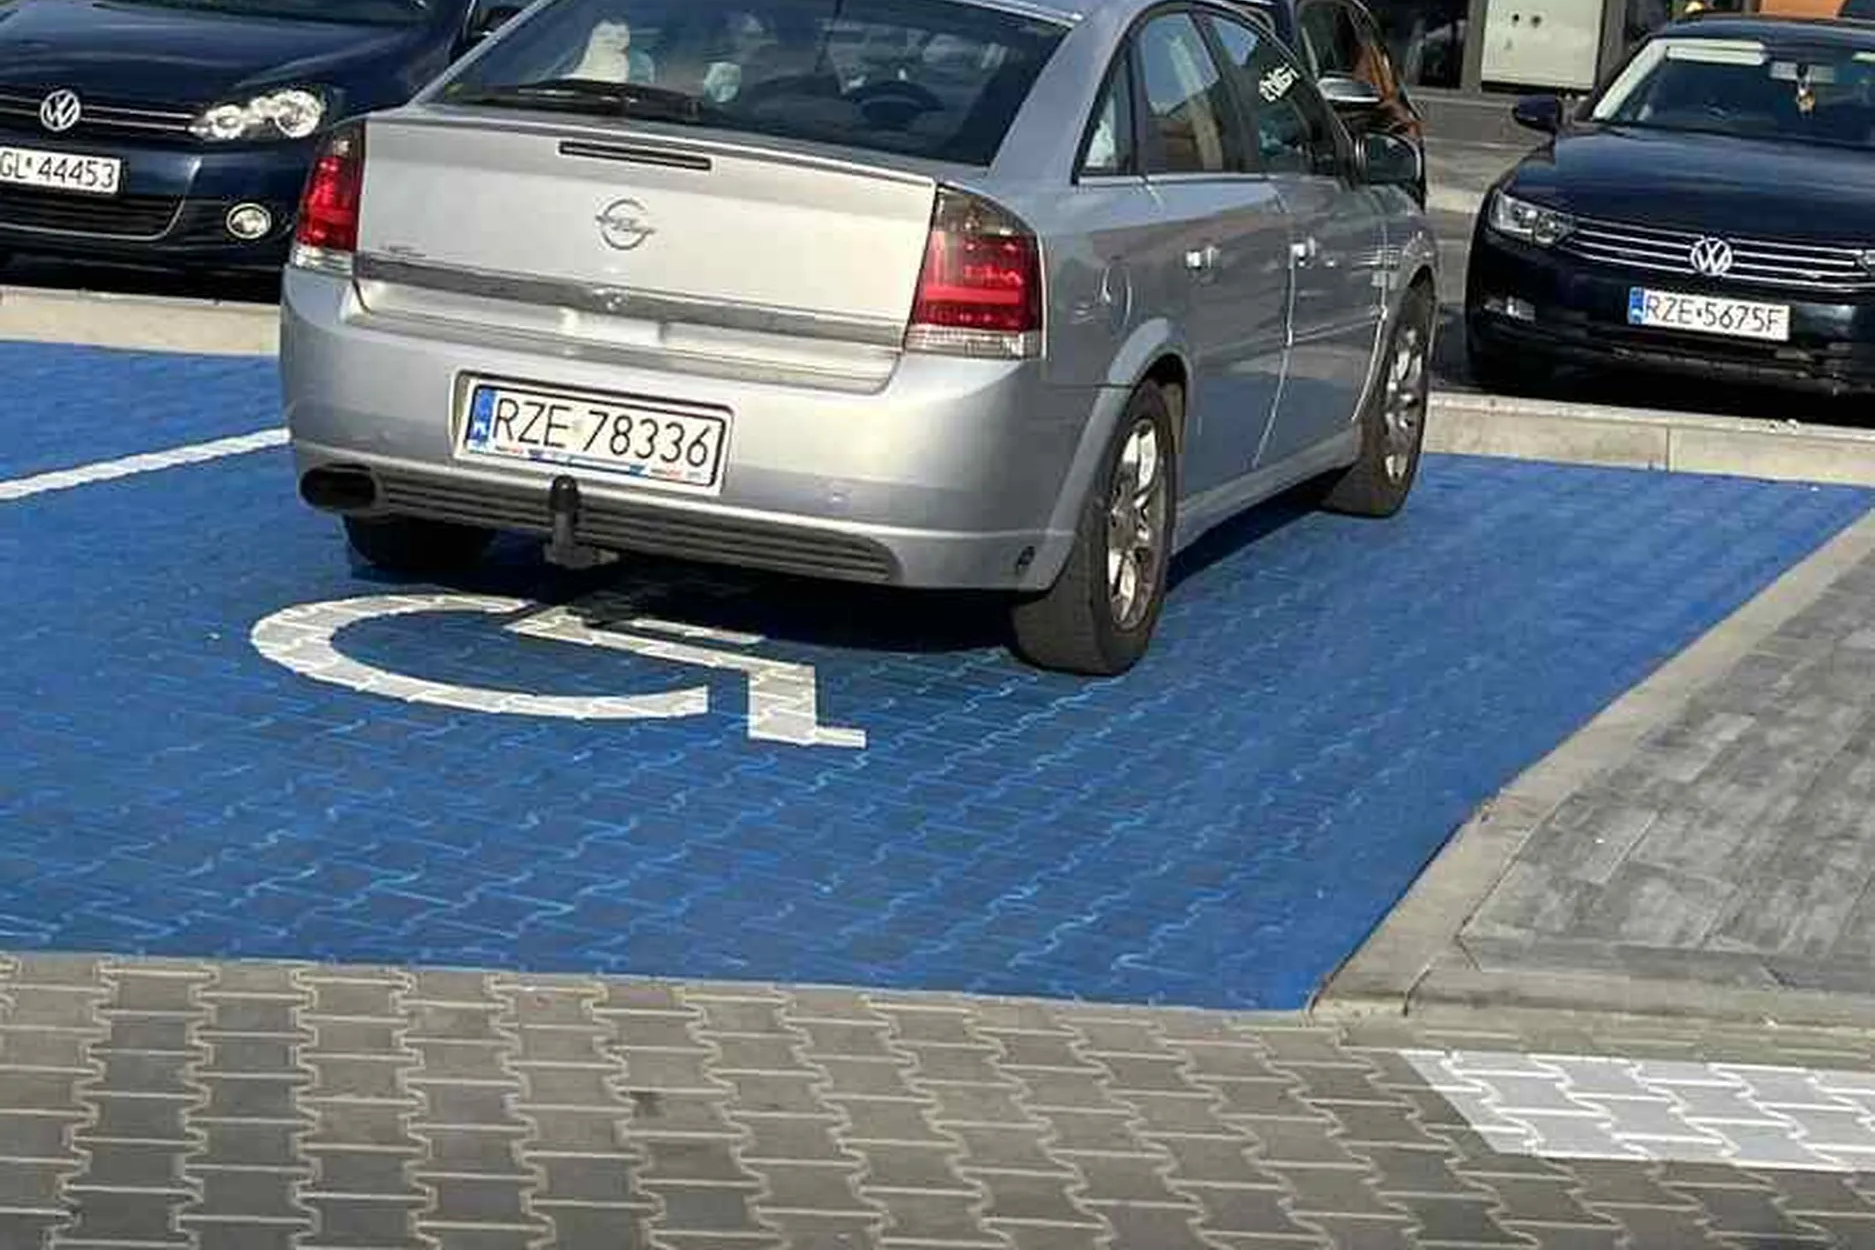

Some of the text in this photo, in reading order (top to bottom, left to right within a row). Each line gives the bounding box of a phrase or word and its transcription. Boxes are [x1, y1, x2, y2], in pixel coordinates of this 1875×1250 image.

[37, 156, 115, 188] 44453
[1645, 295, 1784, 332] RZE 5675F
[492, 398, 711, 467] RZE 78336
